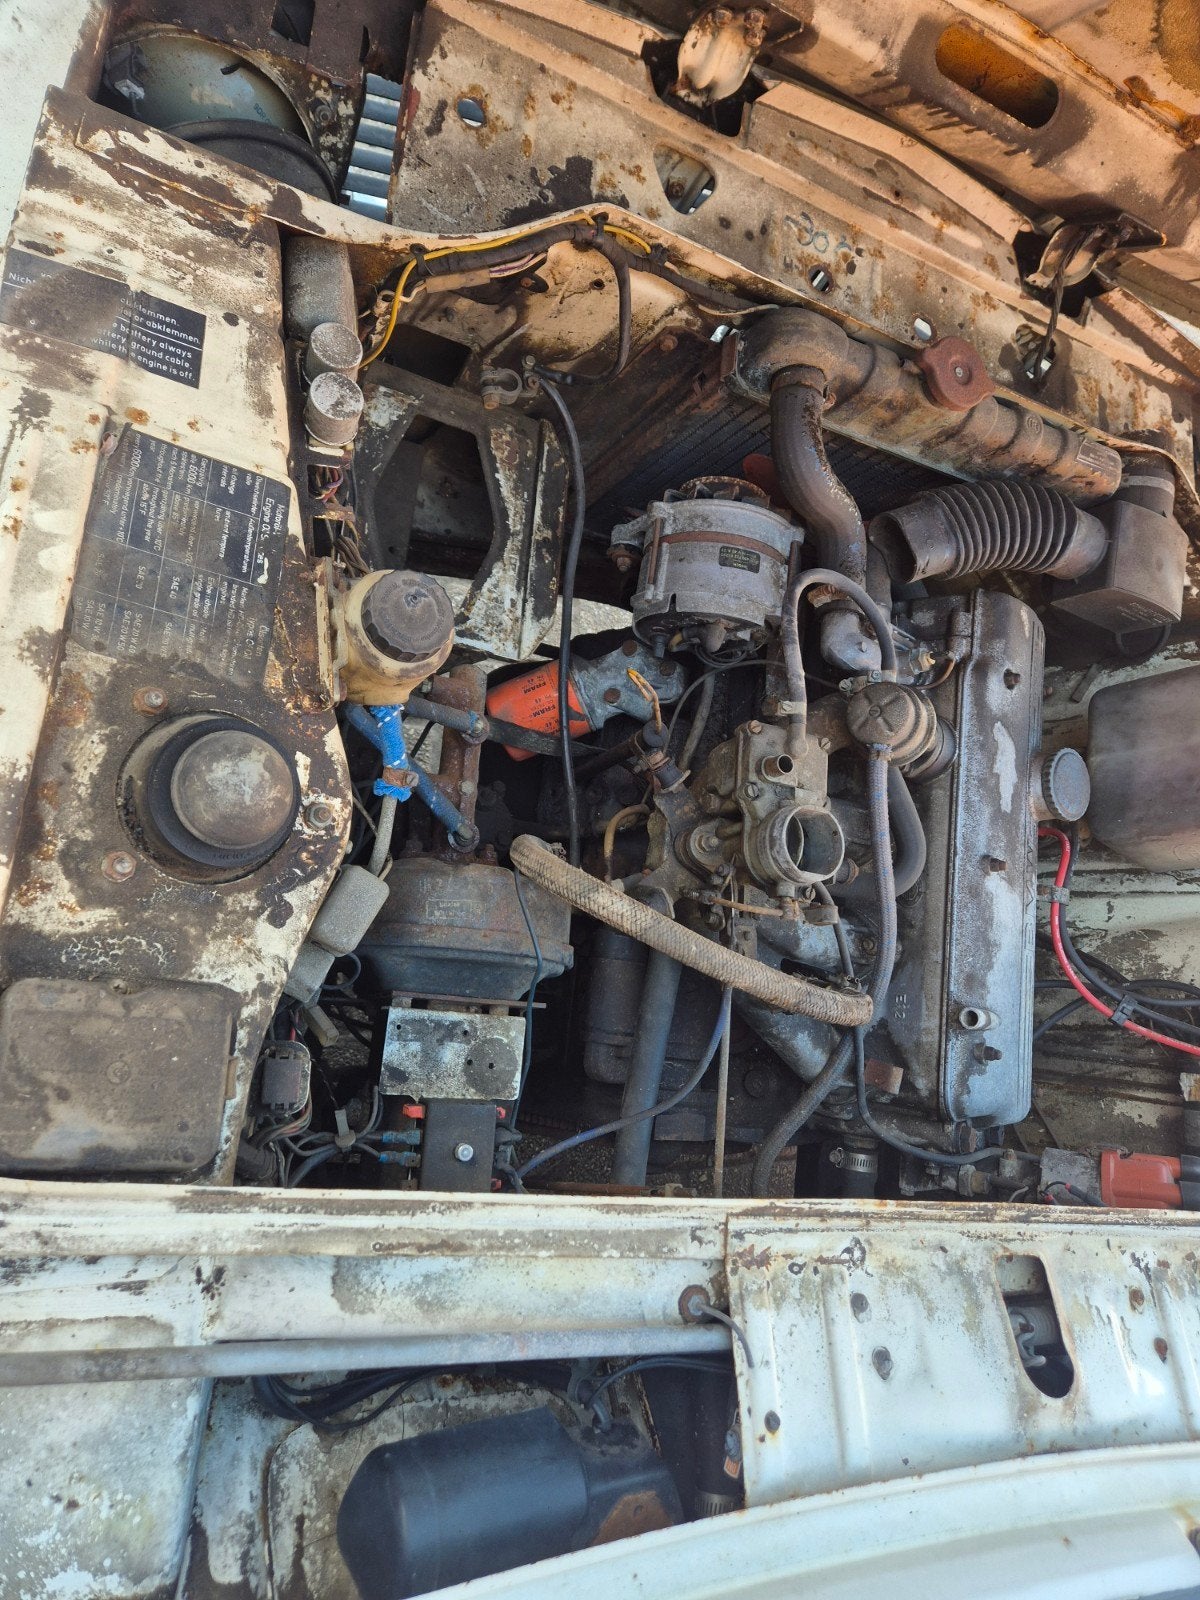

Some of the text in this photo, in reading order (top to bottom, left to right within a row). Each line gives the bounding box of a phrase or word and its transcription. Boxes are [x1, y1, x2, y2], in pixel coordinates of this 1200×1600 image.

[131, 340, 162, 358] ground
[164, 353, 193, 370] cable.
[159, 340, 192, 359] always
[137, 354, 167, 372] engine
[169, 365, 177, 374] is
[179, 369, 195, 381] off.
[130, 447, 141, 468] 6000
[186, 464, 197, 485] 6000
[261, 496, 274, 523] Engine
[136, 564, 145, 581] SAE
[170, 575, 180, 591] SAE
[96, 601, 106, 618] SAE
[122, 608, 131, 626] SAE
[133, 611, 142, 628] SAE
[523, 680, 547, 694] FRAM
[532, 703, 557, 718] FRAM
